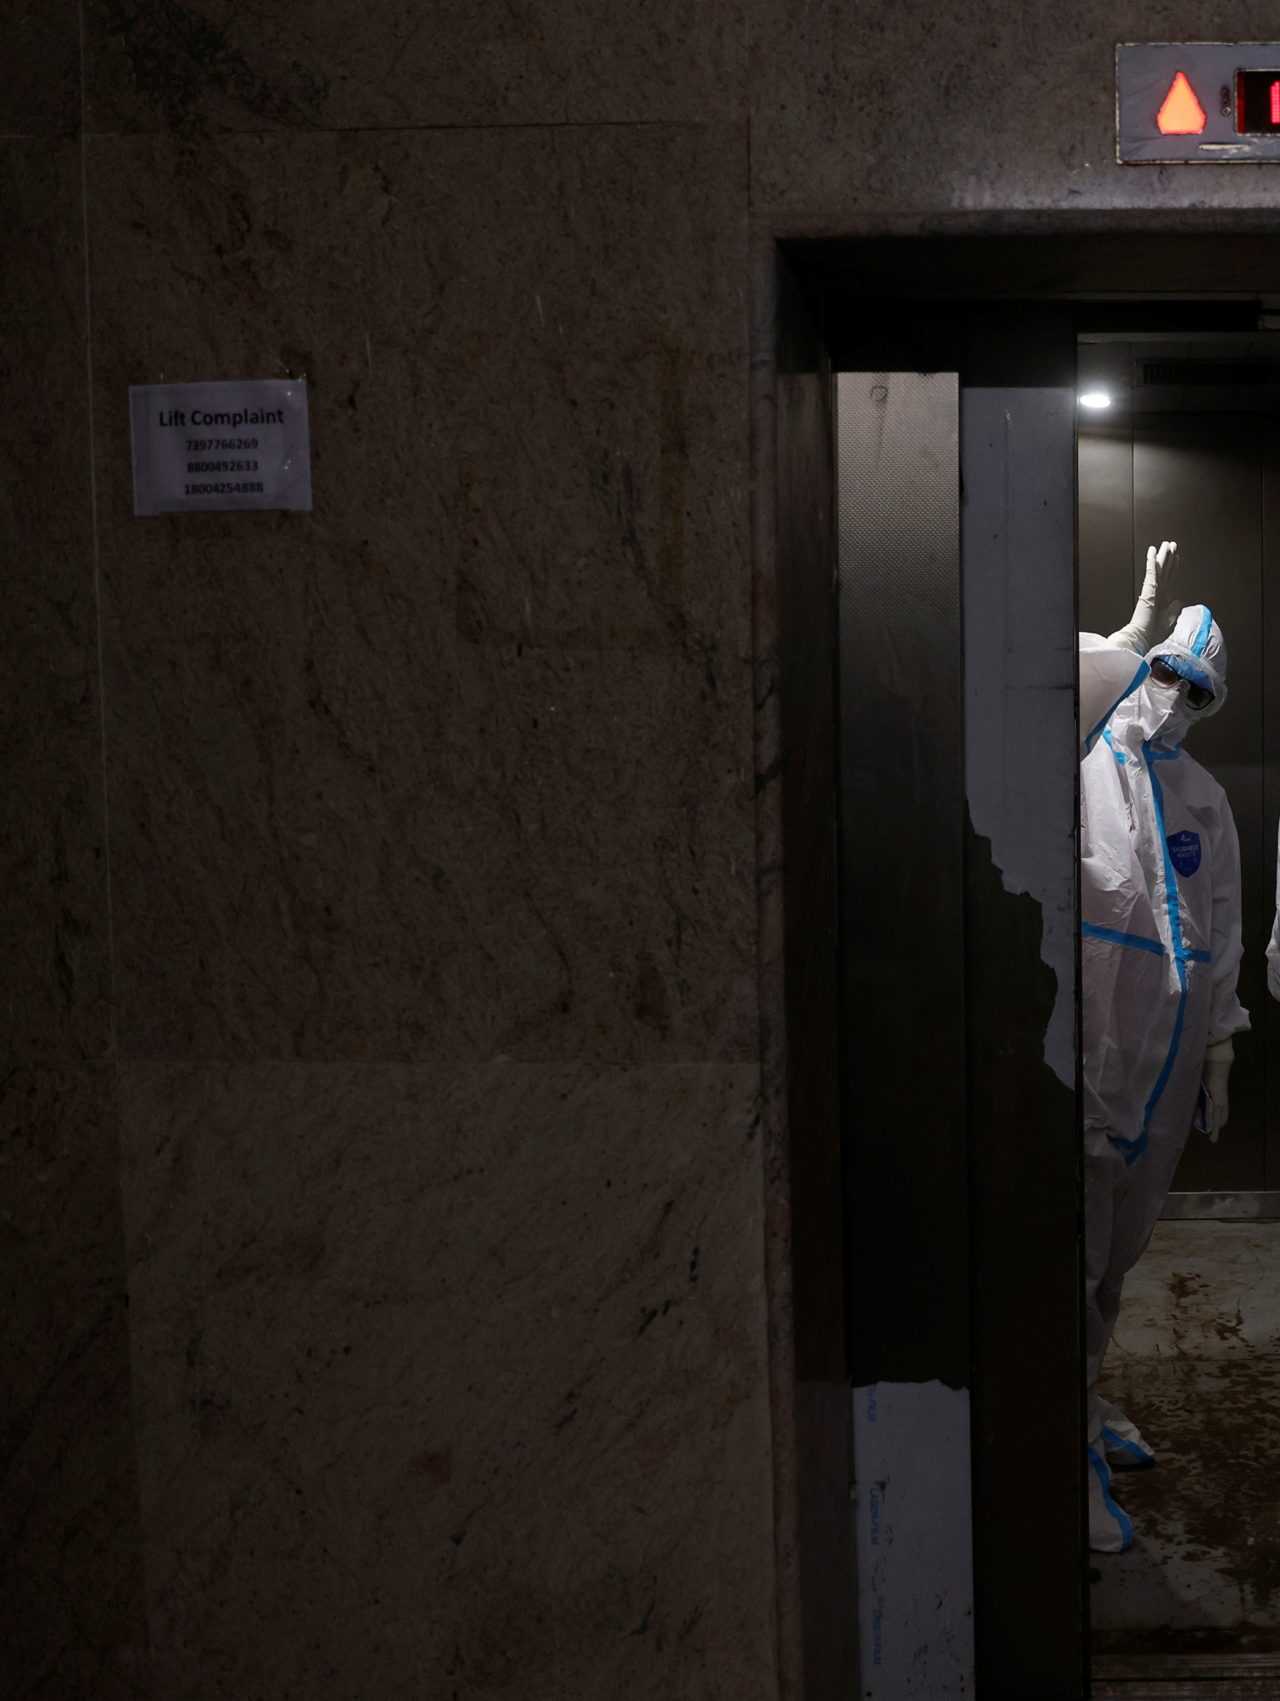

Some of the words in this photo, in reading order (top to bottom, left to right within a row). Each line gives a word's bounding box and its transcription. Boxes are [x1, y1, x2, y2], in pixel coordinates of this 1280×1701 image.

[159, 410, 185, 427] Lift
[191, 408, 284, 428] Complaint
[186, 438, 258, 451] 7397766269
[187, 460, 258, 473] 8800492633
[185, 482, 263, 495] 18004254888
